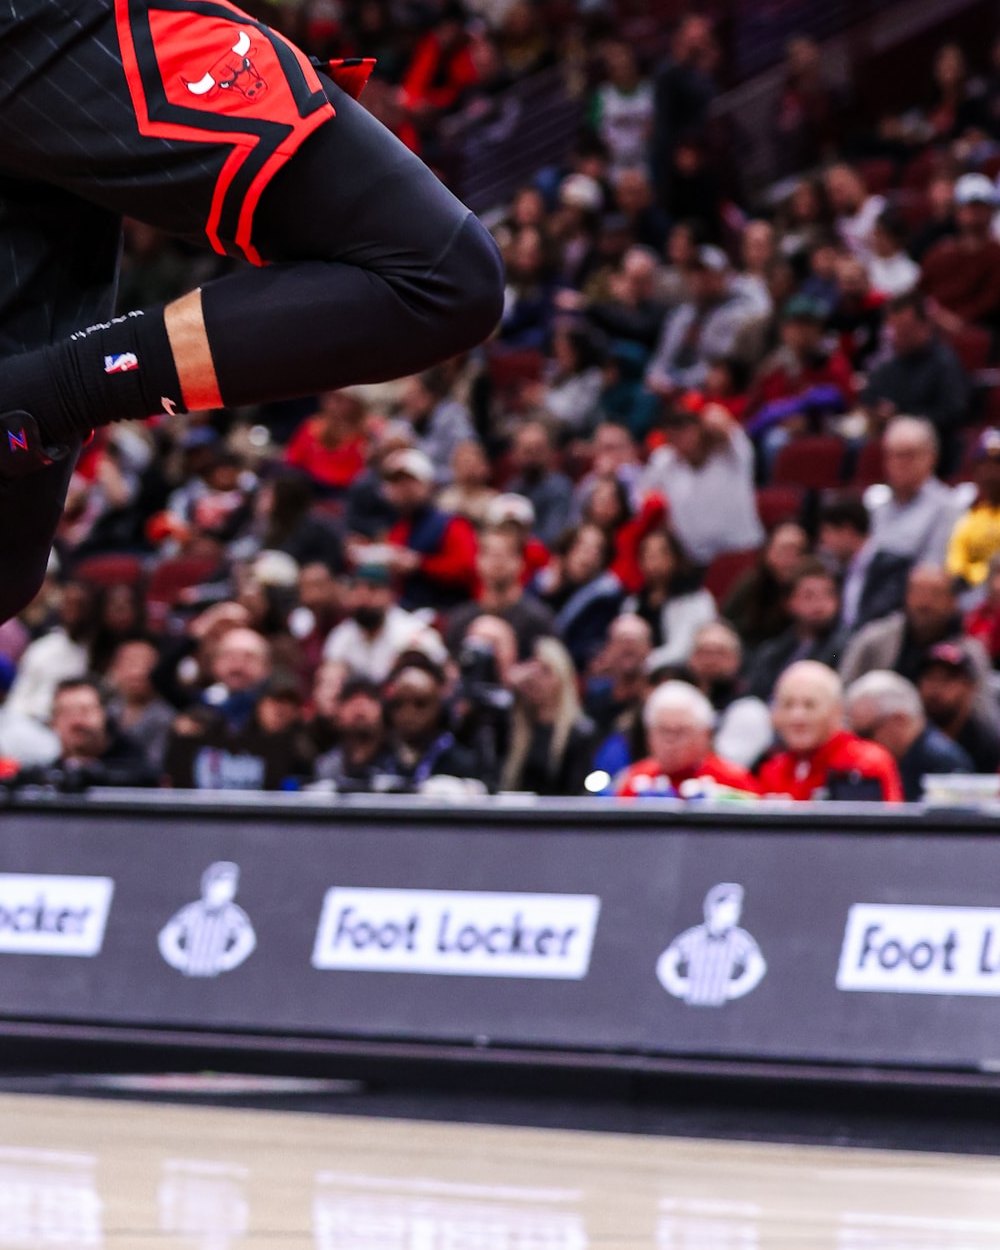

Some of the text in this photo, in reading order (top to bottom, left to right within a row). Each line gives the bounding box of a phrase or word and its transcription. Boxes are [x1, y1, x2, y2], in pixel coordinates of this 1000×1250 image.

[333, 906, 578, 957] Foot Locker
[857, 923, 957, 975] Foot
